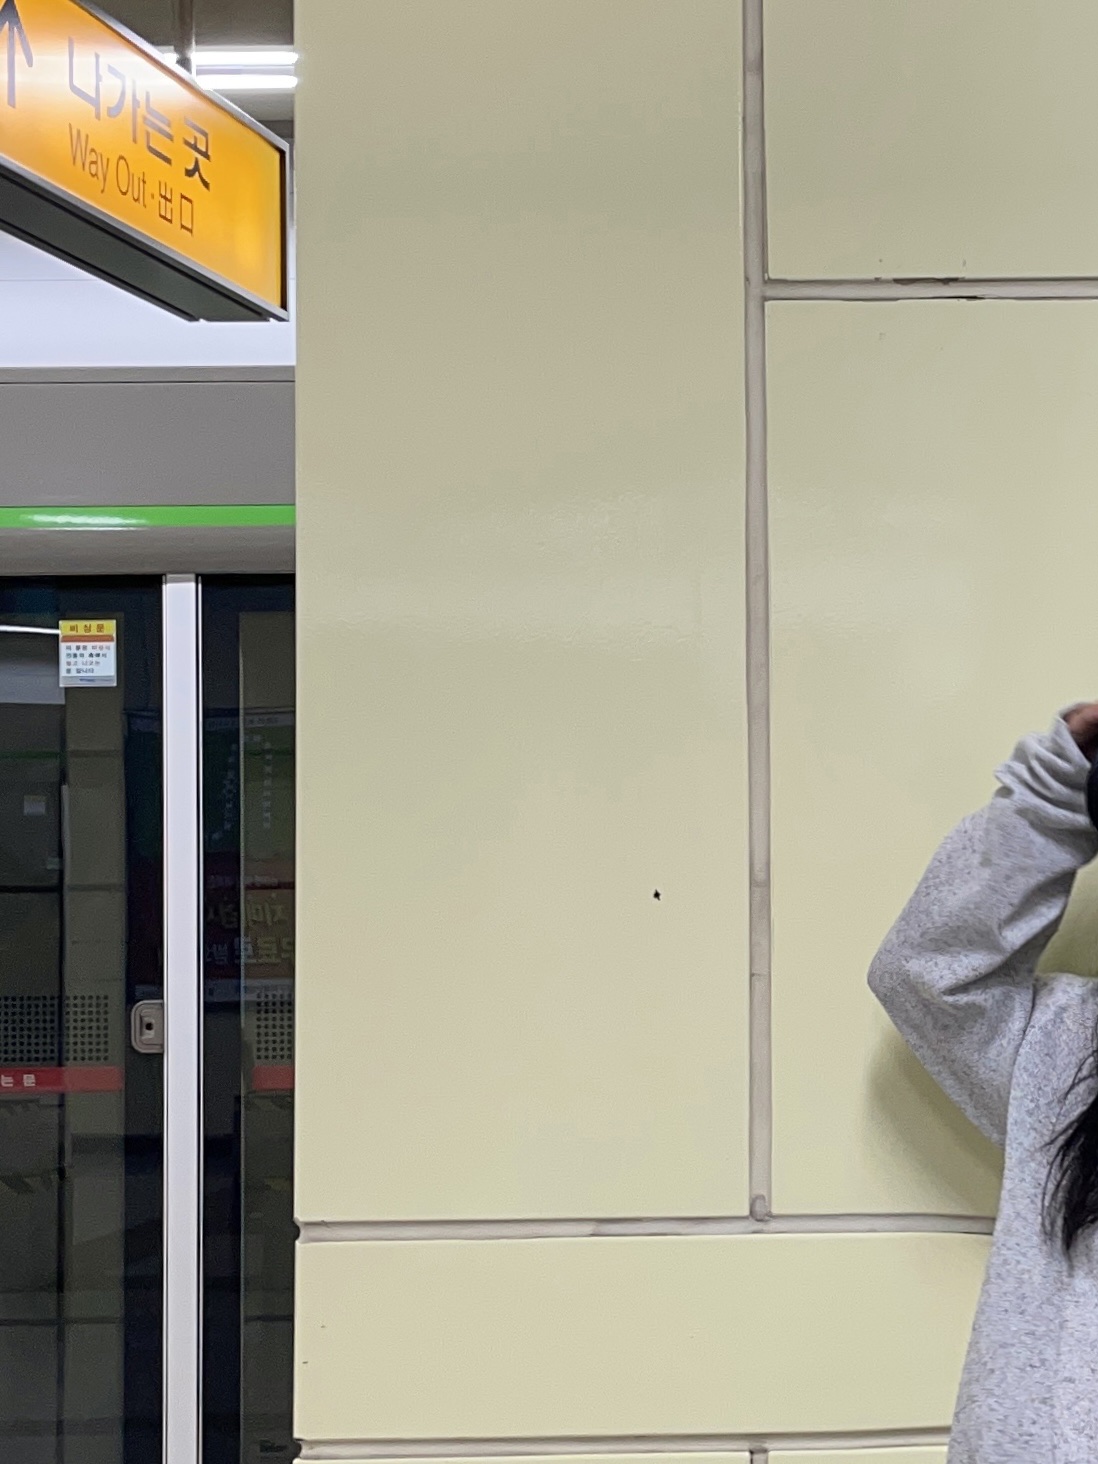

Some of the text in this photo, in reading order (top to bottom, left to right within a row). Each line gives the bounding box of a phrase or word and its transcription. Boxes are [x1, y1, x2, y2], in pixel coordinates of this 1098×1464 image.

[68, 36, 211, 192] 나가는 곳
[68, 122, 147, 208] Way Out
[158, 180, 194, 237] 出口
